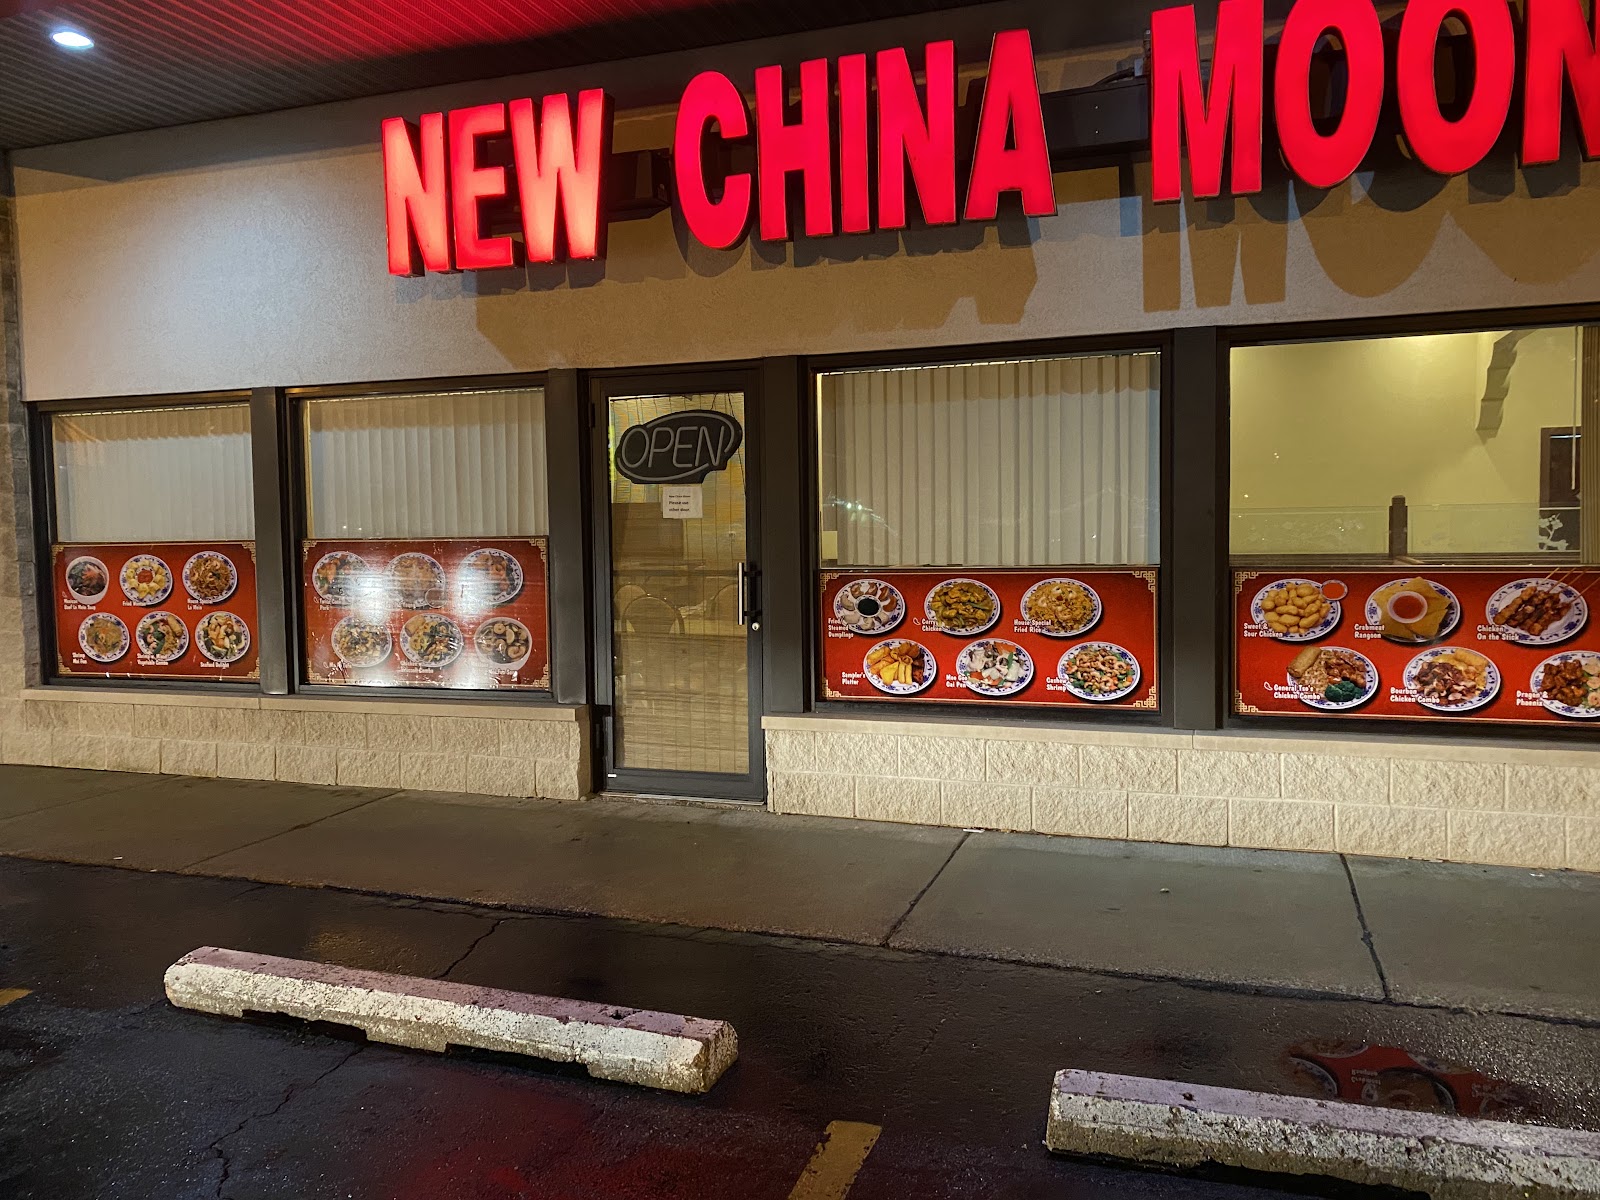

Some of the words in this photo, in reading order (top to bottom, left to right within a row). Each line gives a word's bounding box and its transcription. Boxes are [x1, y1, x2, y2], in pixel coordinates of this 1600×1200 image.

[382, 88, 605, 277] NEW
[674, 28, 1056, 250] CHINA
[1151, 0, 1600, 204] MOON
[621, 425, 725, 468] OPEN
[1031, 619, 1052, 628] Special
[1243, 622, 1261, 630] Sweet
[1029, 626, 1042, 634] Rice
[1476, 624, 1504, 633] Chicken
[828, 631, 854, 640] Dumplings
[1243, 630, 1258, 638] Sour
[1258, 630, 1283, 638] Chicken
[1354, 631, 1382, 640] Rangoon
[1476, 632, 1487, 641] On
[1488, 632, 1500, 640] the
[1501, 632, 1520, 641] Stick
[841, 671, 866, 680] Sampler's
[1046, 684, 1067, 693] Shrimp
[1273, 683, 1297, 691] General
[1297, 683, 1314, 692] Tso's
[1390, 686, 1418, 695] Bourbon
[1273, 691, 1299, 700] Chicken
[1299, 691, 1321, 700] Combo
[1390, 694, 1416, 703] Chicken
[1416, 694, 1440, 704] Combo
[1516, 690, 1541, 700] Dragon
[1541, 690, 1549, 699] &
[1516, 698, 1543, 706] Phoenix
